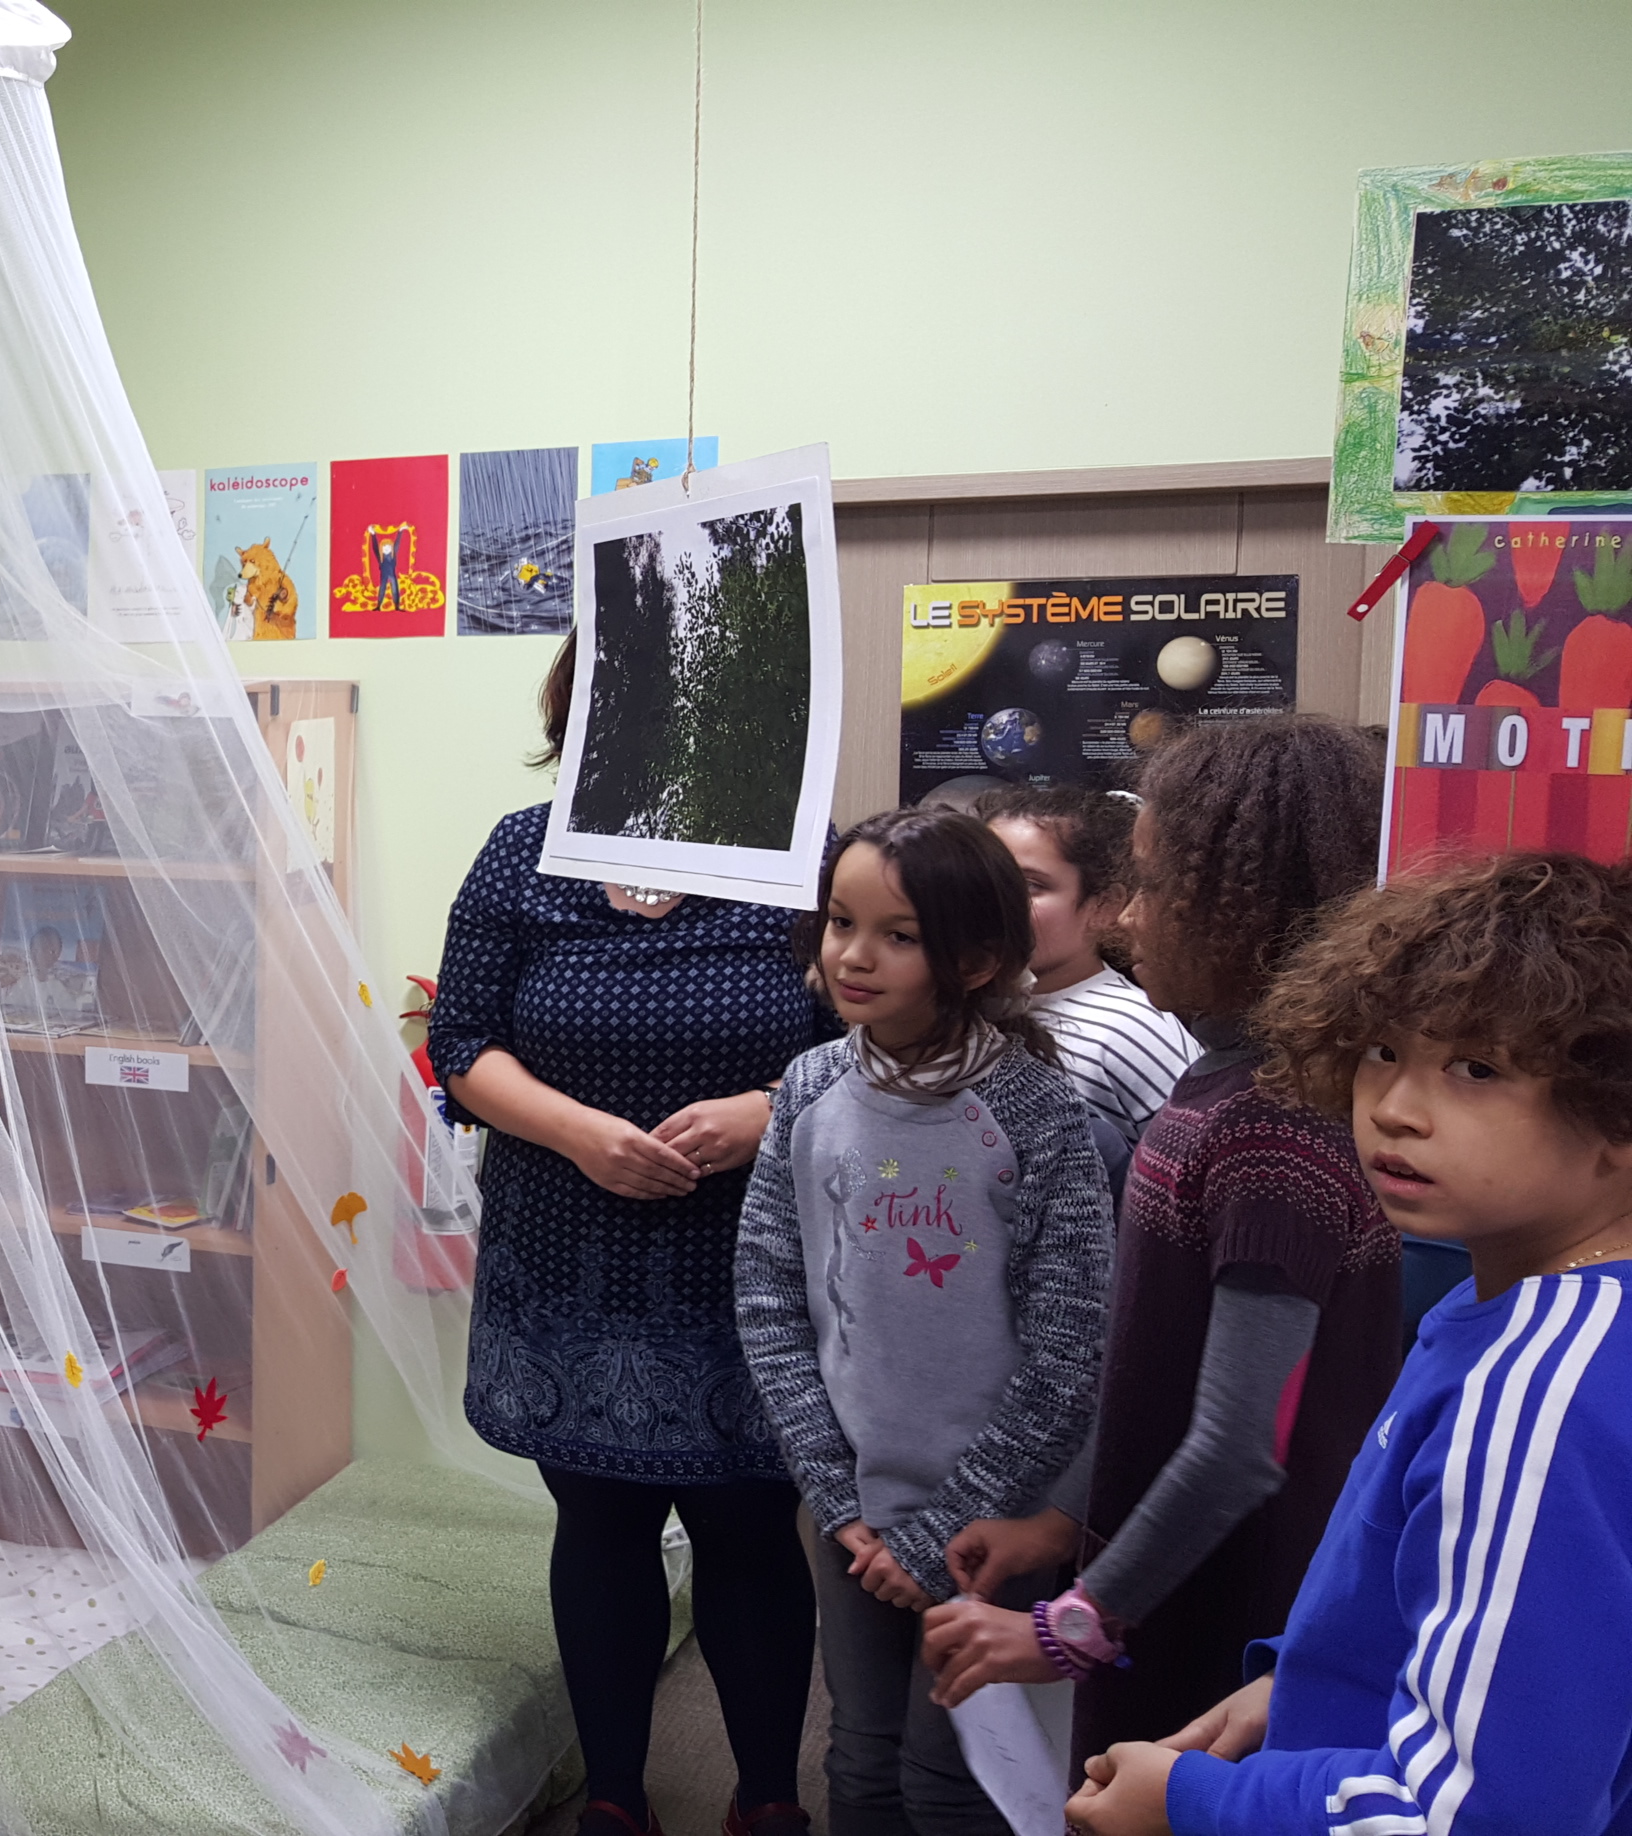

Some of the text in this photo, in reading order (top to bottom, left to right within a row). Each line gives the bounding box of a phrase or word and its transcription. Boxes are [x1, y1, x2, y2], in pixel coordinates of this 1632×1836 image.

[209, 476, 310, 491] kaléidoscope
[1494, 532, 1622, 549] catherine
[910, 591, 1287, 627] LE SYSTÈME SOLAIRE
[927, 663, 958, 686] Soleil
[967, 712, 984, 720] Terre
[1209, 707, 1238, 715] ceinture
[1028, 774, 1051, 782] Jupiter
[109, 1053, 161, 1065] English books
[874, 1184, 963, 1236] Tink
